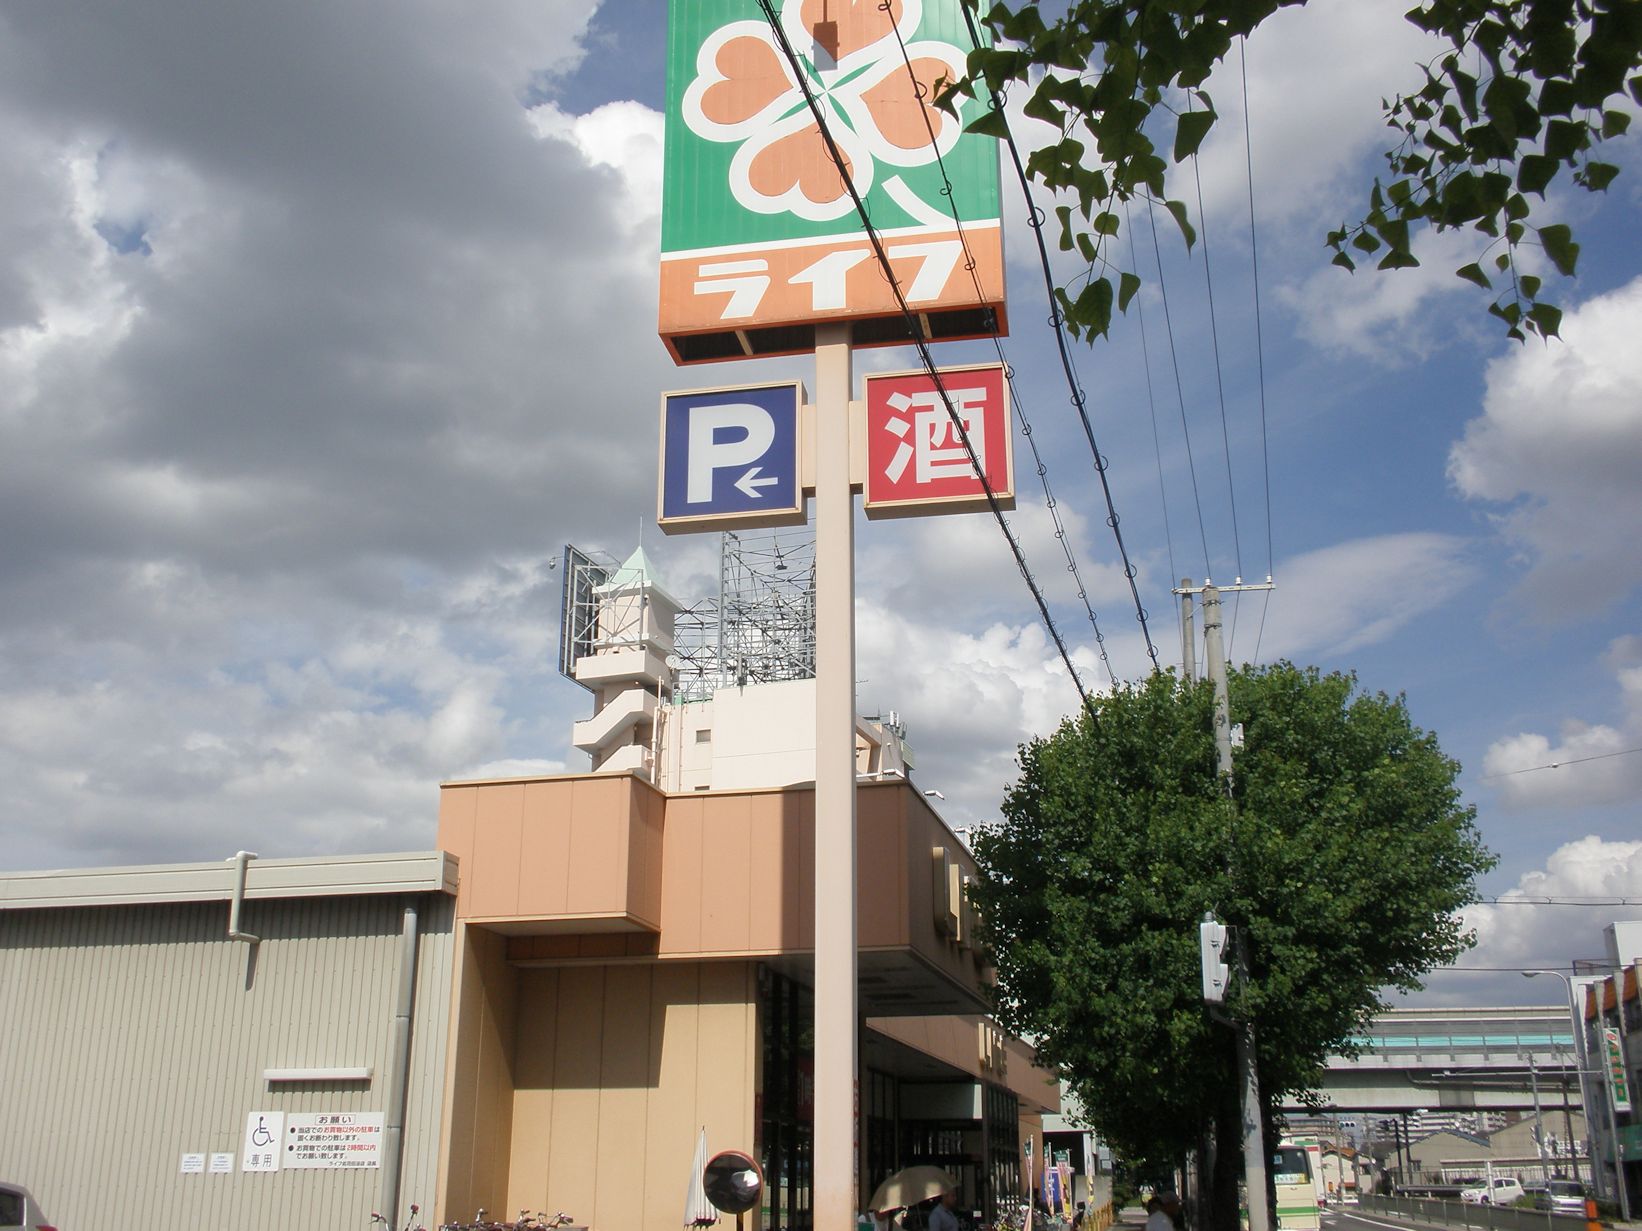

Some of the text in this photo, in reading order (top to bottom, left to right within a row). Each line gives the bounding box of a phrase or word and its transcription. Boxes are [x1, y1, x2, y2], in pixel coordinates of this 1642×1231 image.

[694, 240, 963, 320] ライフ
[687, 403, 776, 504] P
[884, 387, 988, 485] 酒
[318, 1116, 352, 1124] お願い
[251, 1153, 272, 1168] 専用
